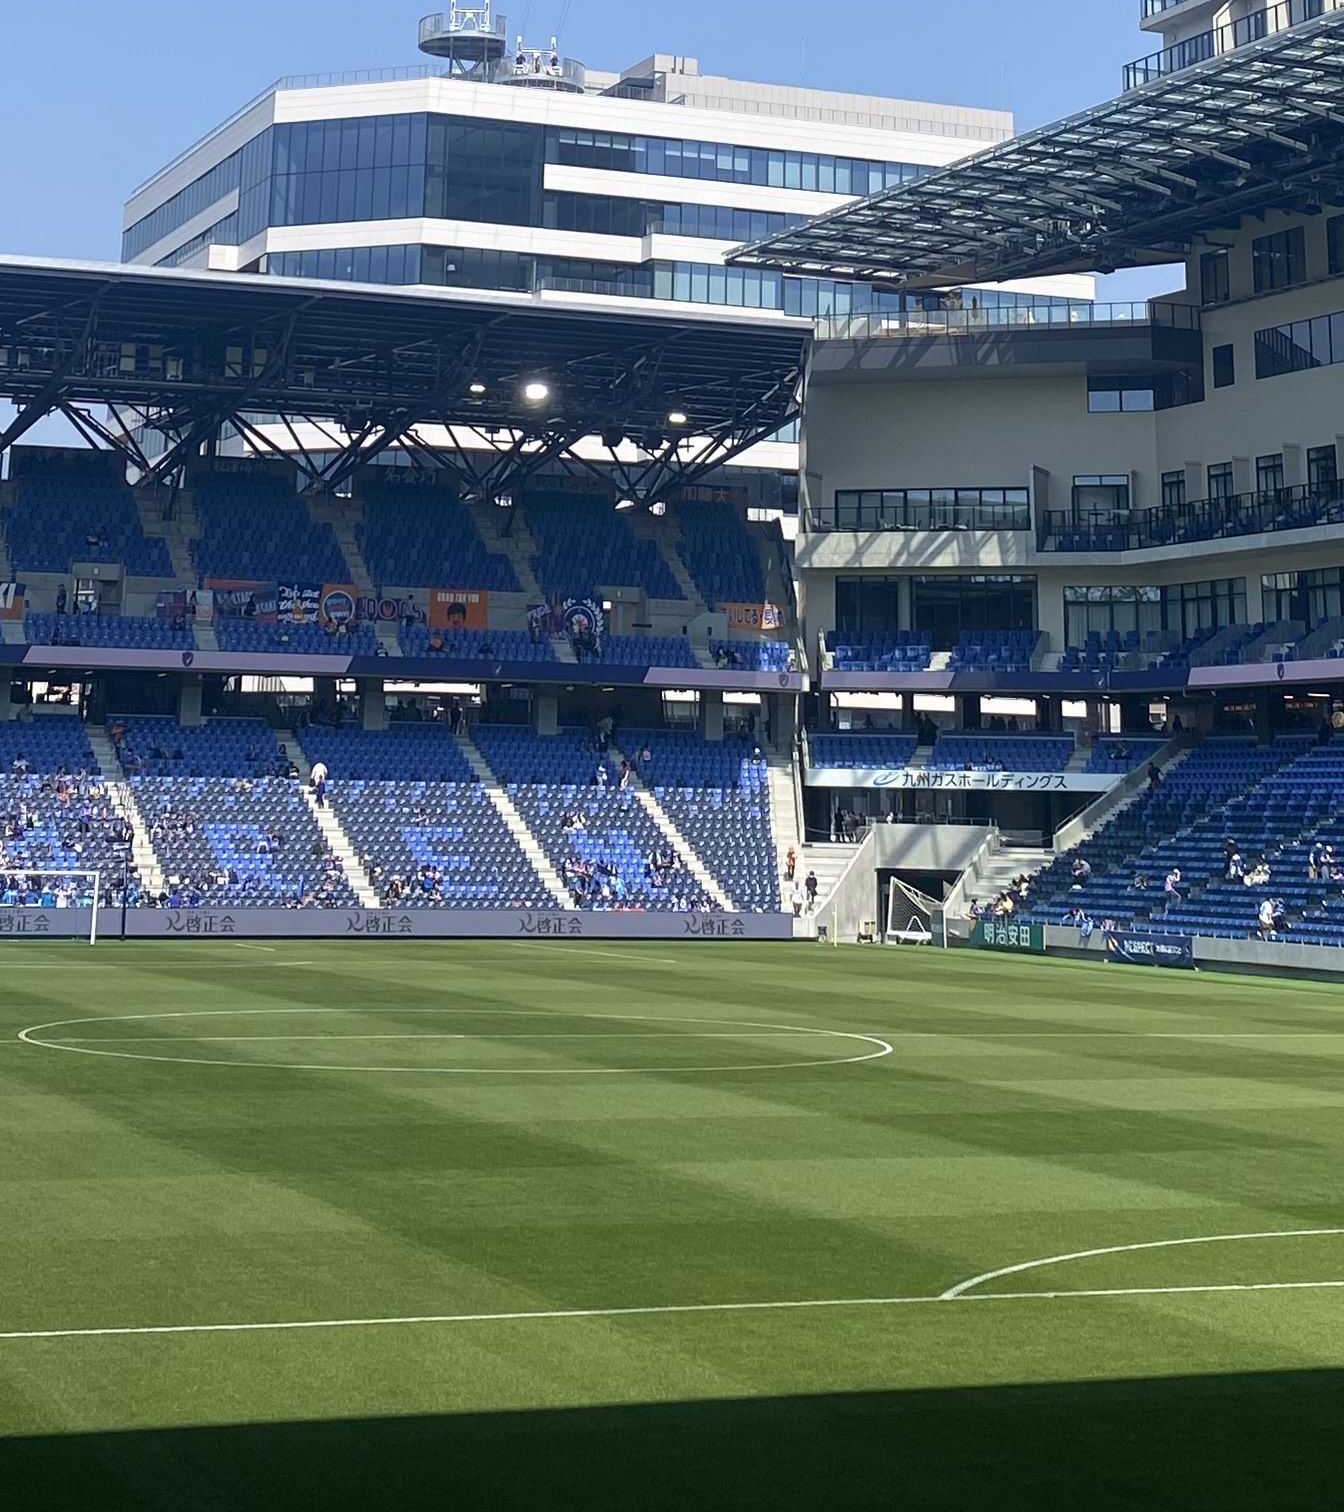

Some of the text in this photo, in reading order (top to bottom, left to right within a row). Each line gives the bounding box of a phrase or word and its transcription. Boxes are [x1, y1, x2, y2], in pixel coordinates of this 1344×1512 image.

[902, 771, 1068, 790] 九州ガスホールディングス
[185, 915, 236, 934] 啓正会
[365, 916, 414, 934] 啓正会
[537, 917, 583, 935] 啓正会
[701, 918, 746, 936] 啓正会
[983, 922, 1031, 947] 明治安田
[1123, 939, 1154, 956] RESPECT
